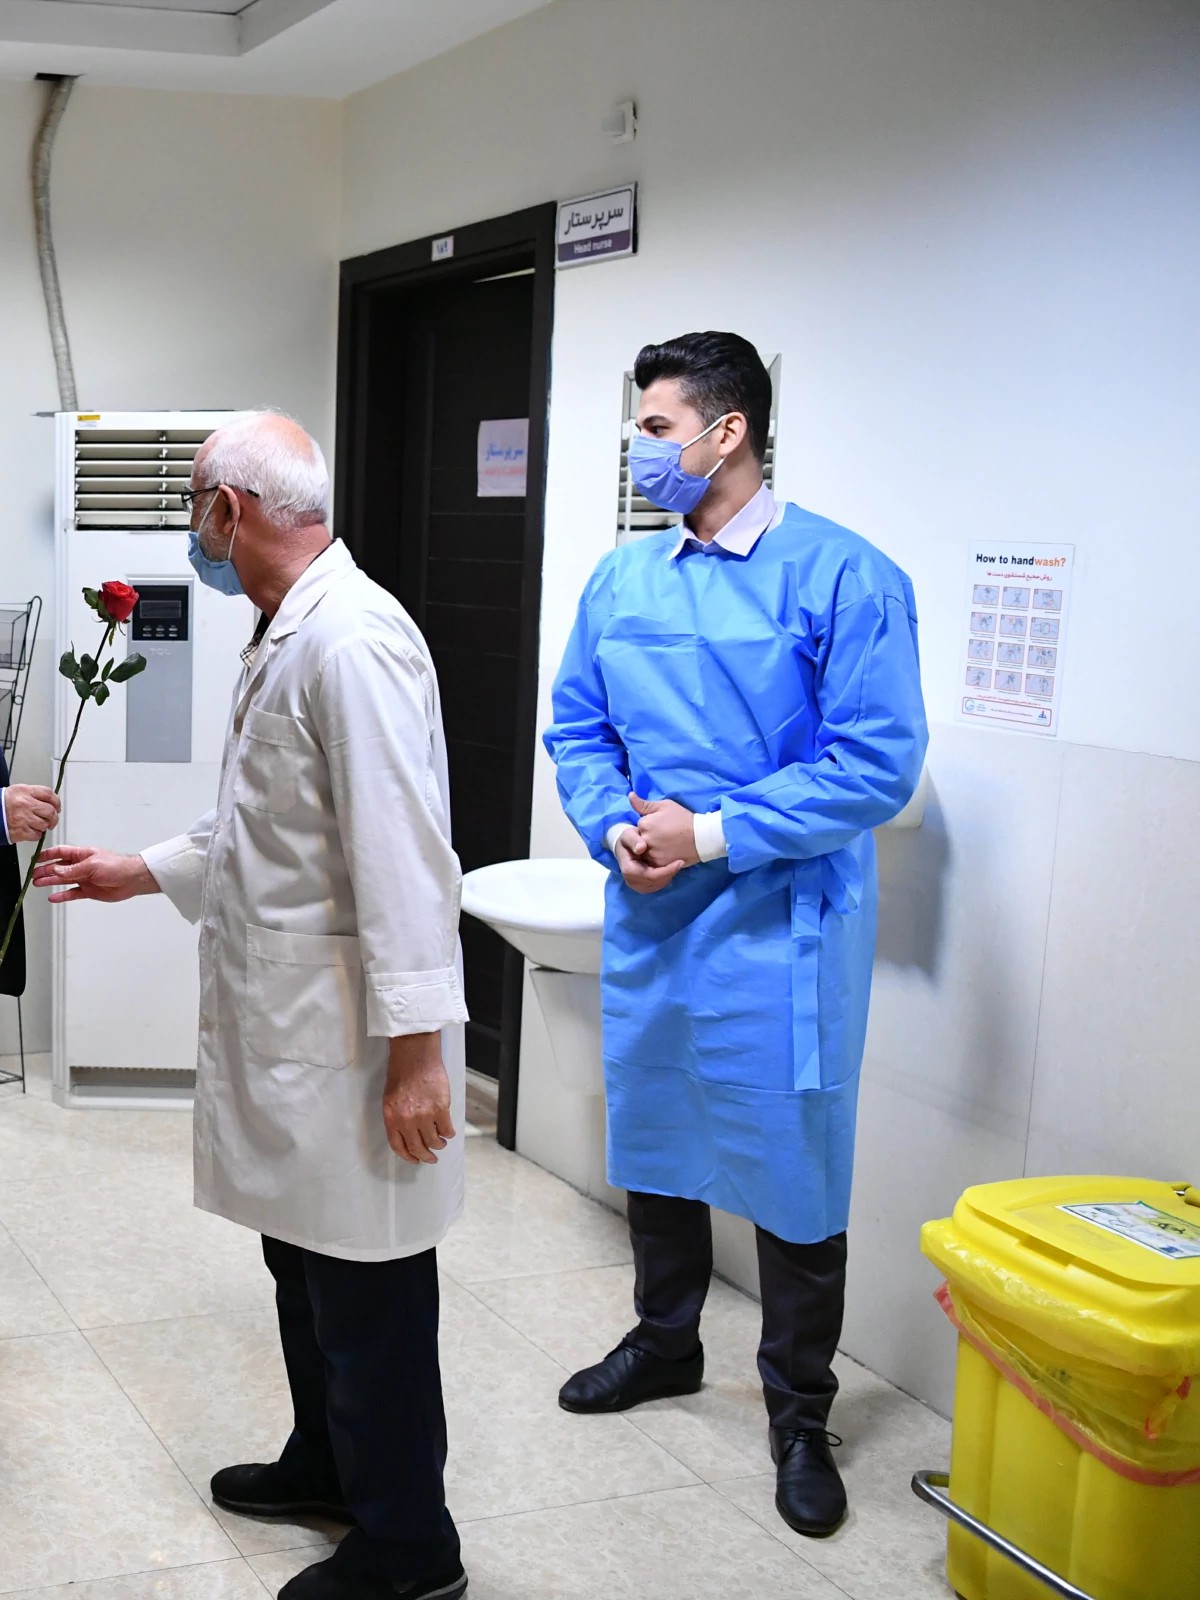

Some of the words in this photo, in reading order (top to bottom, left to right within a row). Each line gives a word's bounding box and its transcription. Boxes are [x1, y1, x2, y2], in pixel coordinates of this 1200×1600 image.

[564, 207, 624, 235] سرپرستار
[574, 241, 592, 254] Head
[592, 239, 612, 250] nurse
[976, 553, 996, 564] How
[999, 555, 1008, 564] to
[1011, 555, 1066, 567] handwash?
